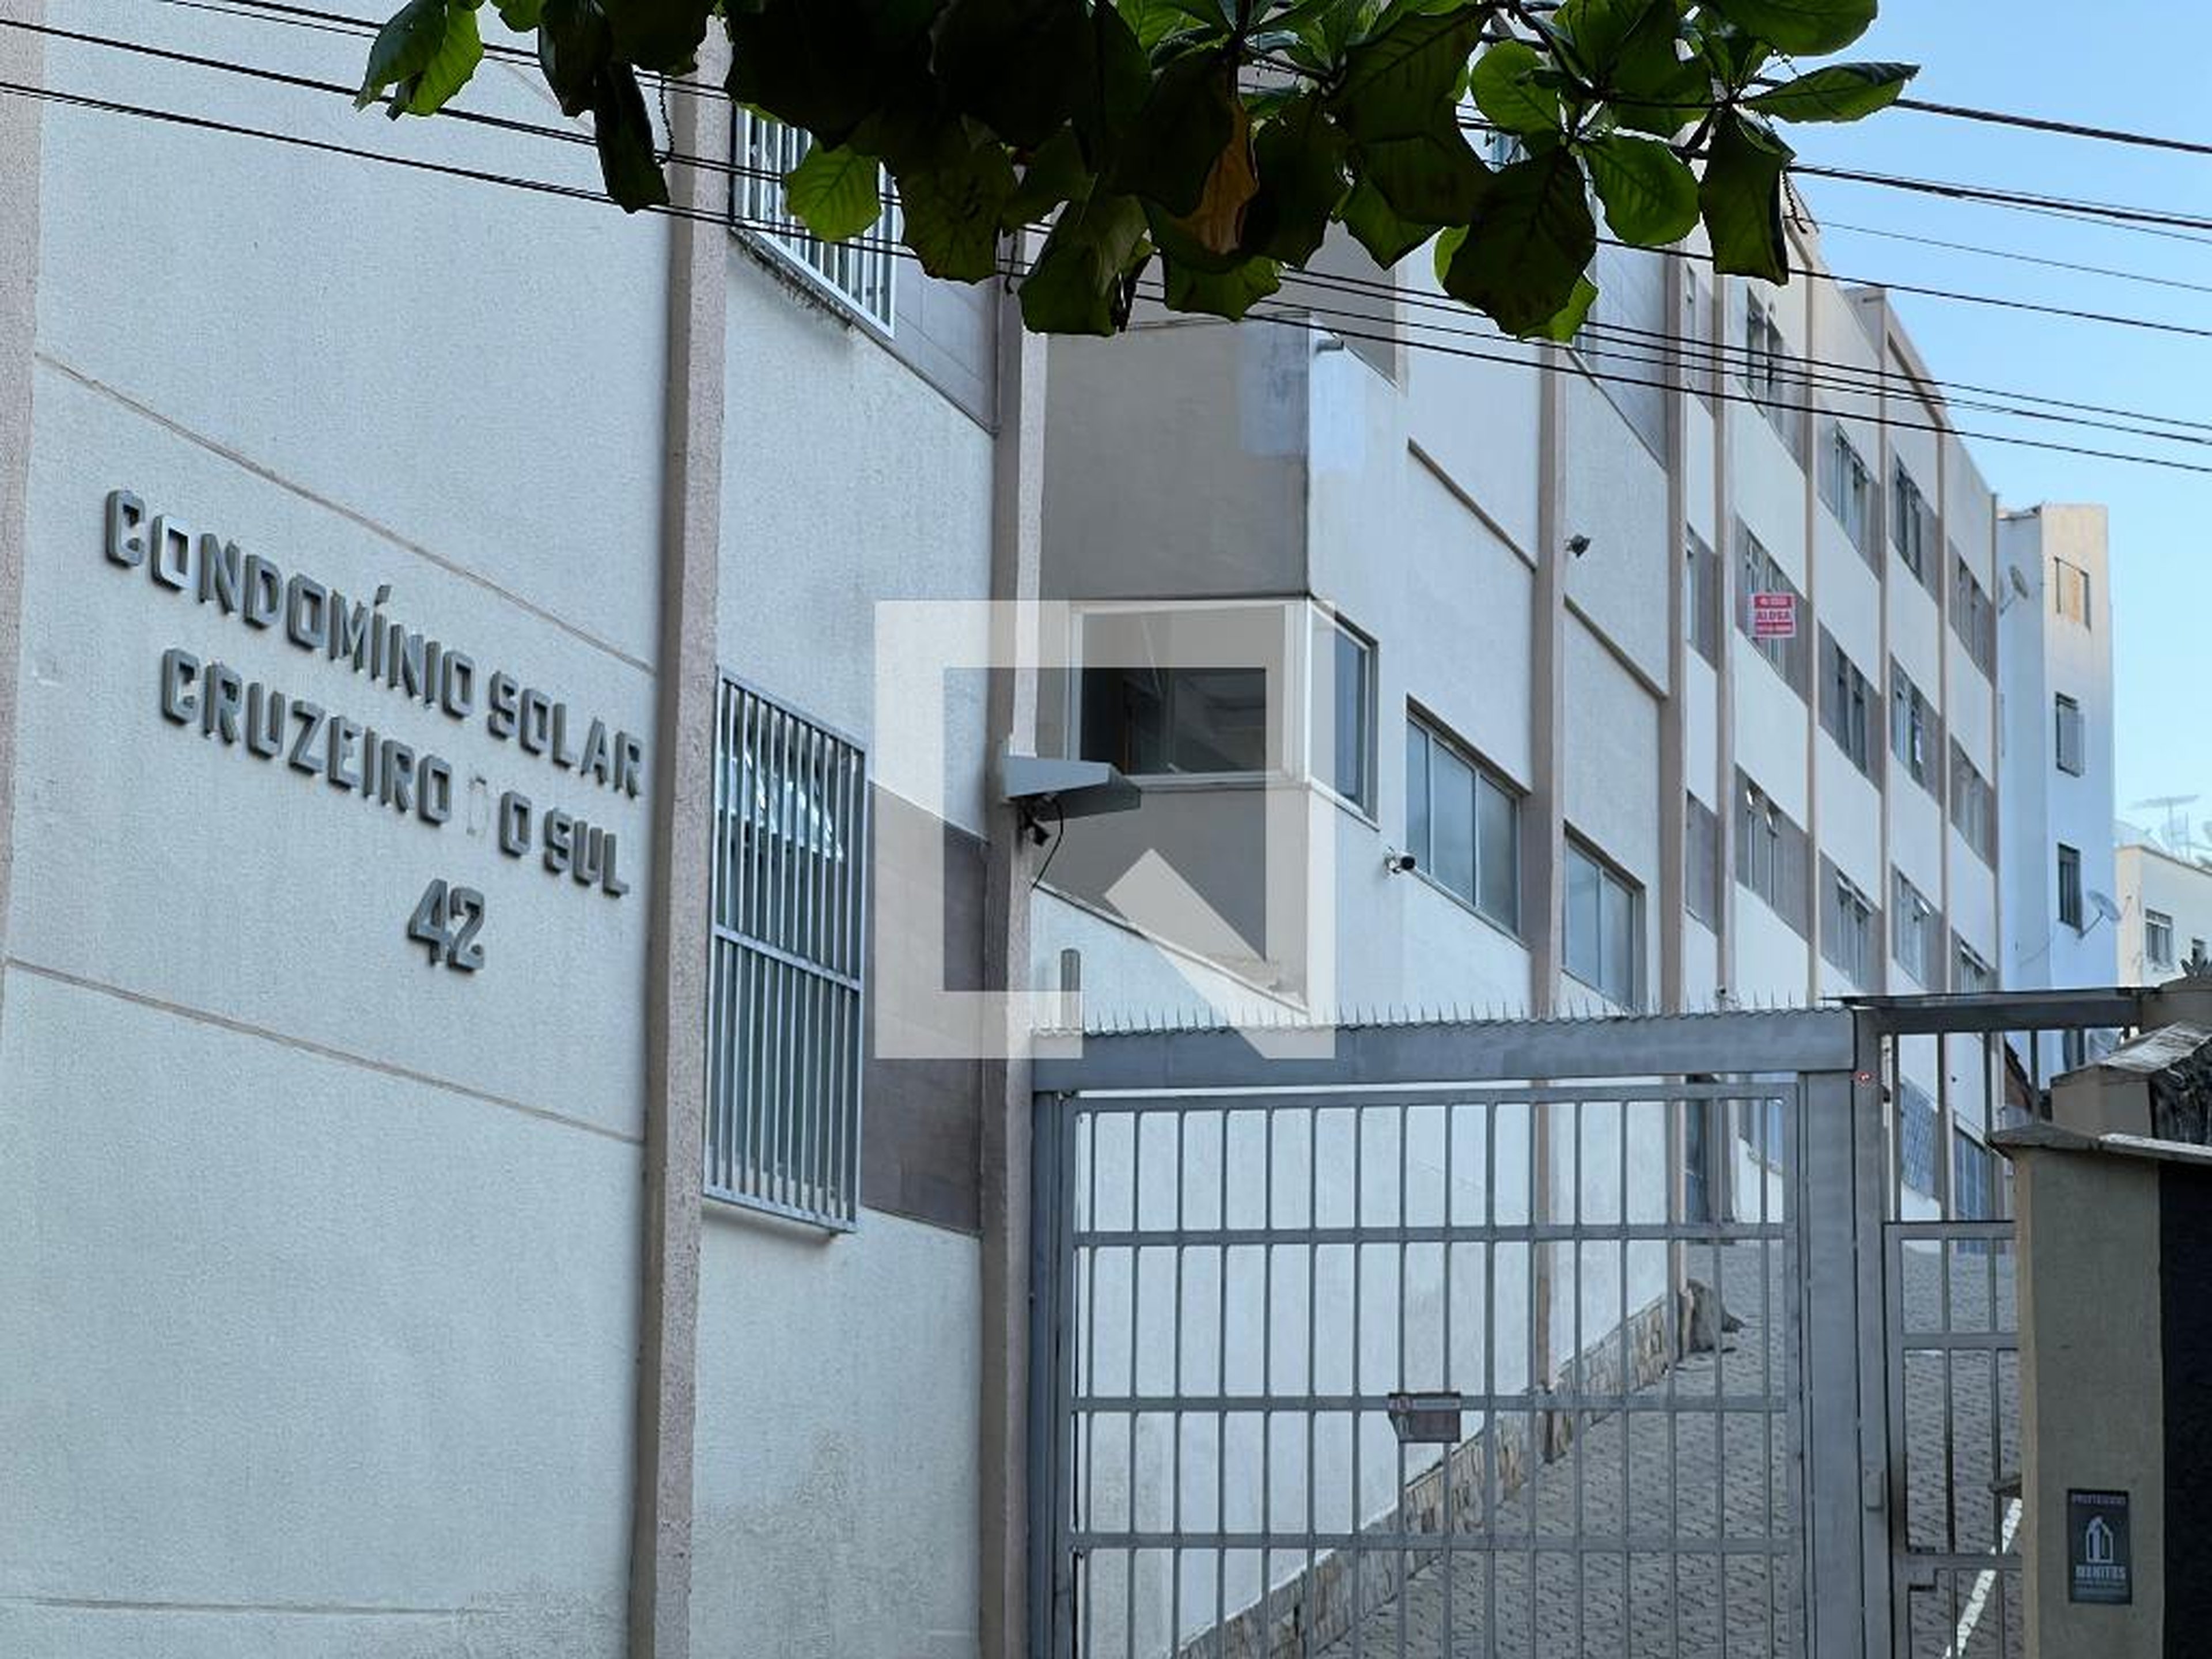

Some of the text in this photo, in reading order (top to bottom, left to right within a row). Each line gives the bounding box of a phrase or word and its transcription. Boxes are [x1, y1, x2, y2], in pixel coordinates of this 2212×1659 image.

[106, 490, 643, 798] CONDOMÍNIO SOLAR
[162, 647, 453, 825] CRUZEIRO
[544, 808, 630, 897] SUL
[407, 878, 486, 971] 42
